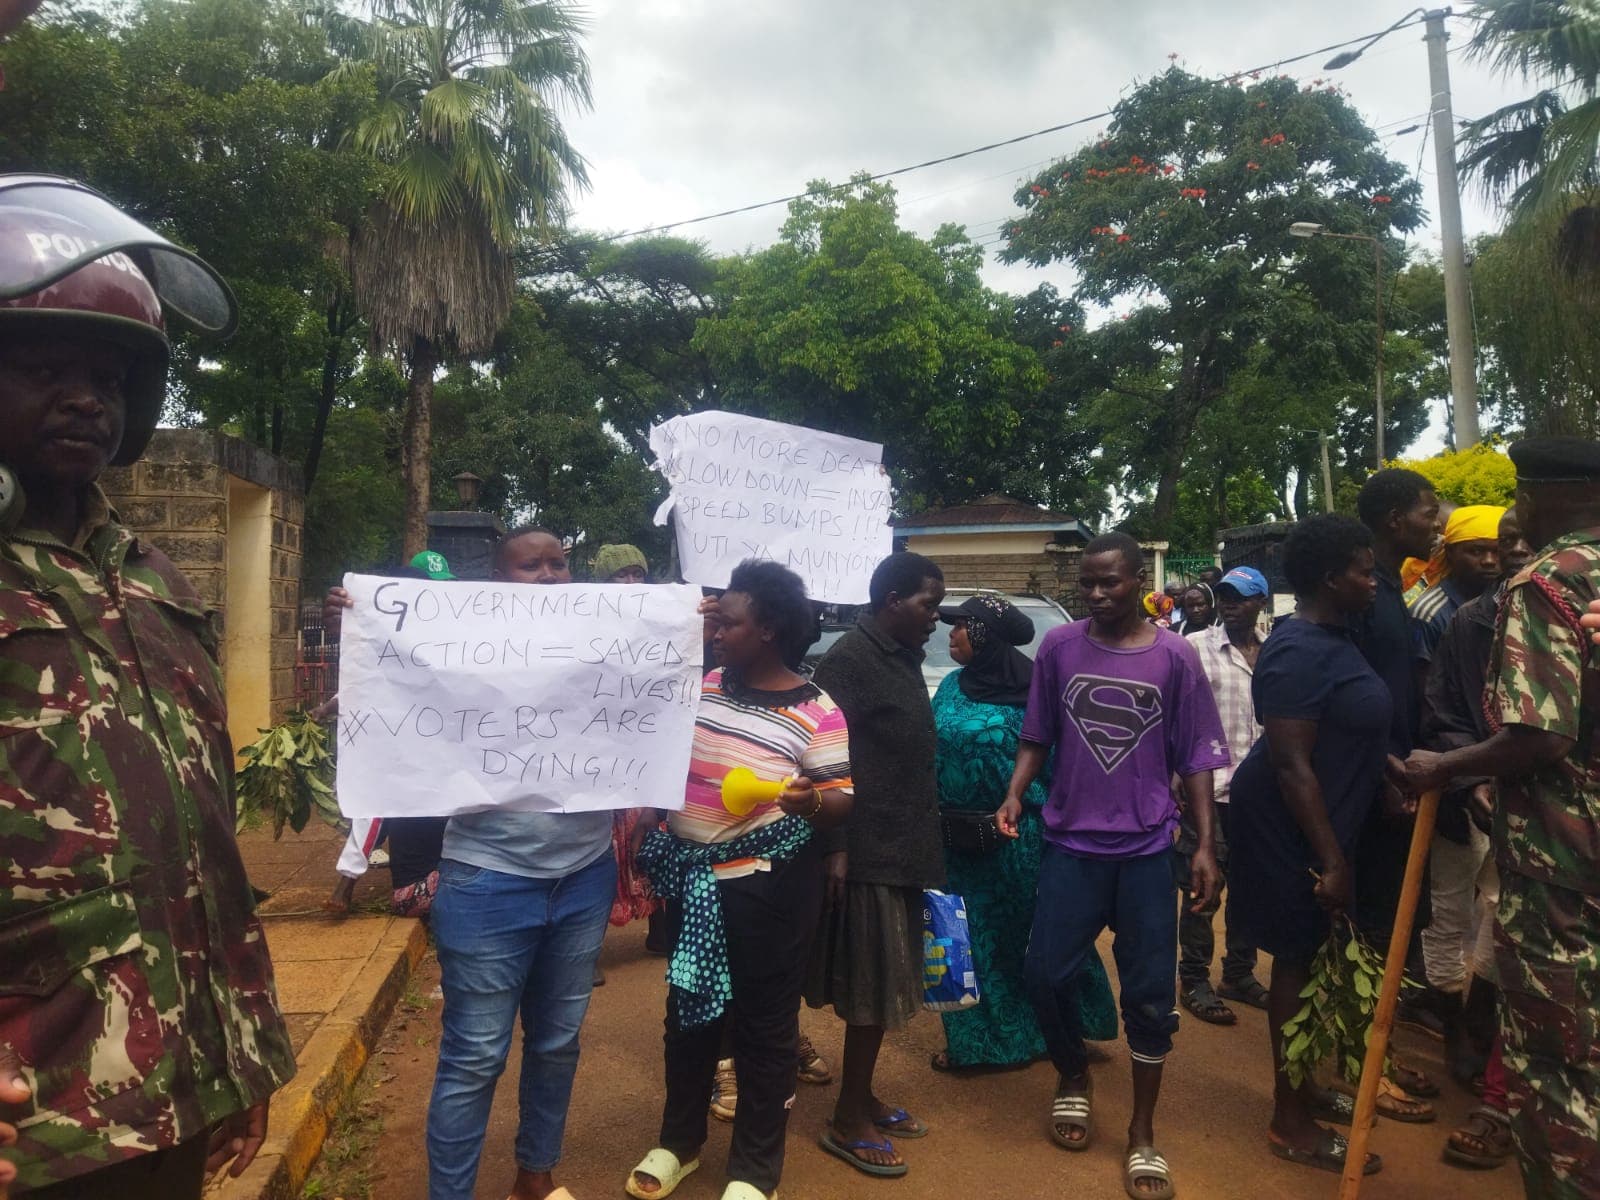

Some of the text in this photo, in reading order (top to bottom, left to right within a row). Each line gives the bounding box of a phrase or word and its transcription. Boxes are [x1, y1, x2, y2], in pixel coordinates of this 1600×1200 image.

[685, 422, 721, 448] NO
[733, 429, 809, 466] MORE
[682, 495, 750, 521] SPEED
[373, 582, 652, 632] GOVERNMENT
[377, 638, 530, 668] ACTION
[579, 638, 683, 666] SAVED
[592, 673, 695, 708] LIVES!!
[580, 707, 658, 735] ARE
